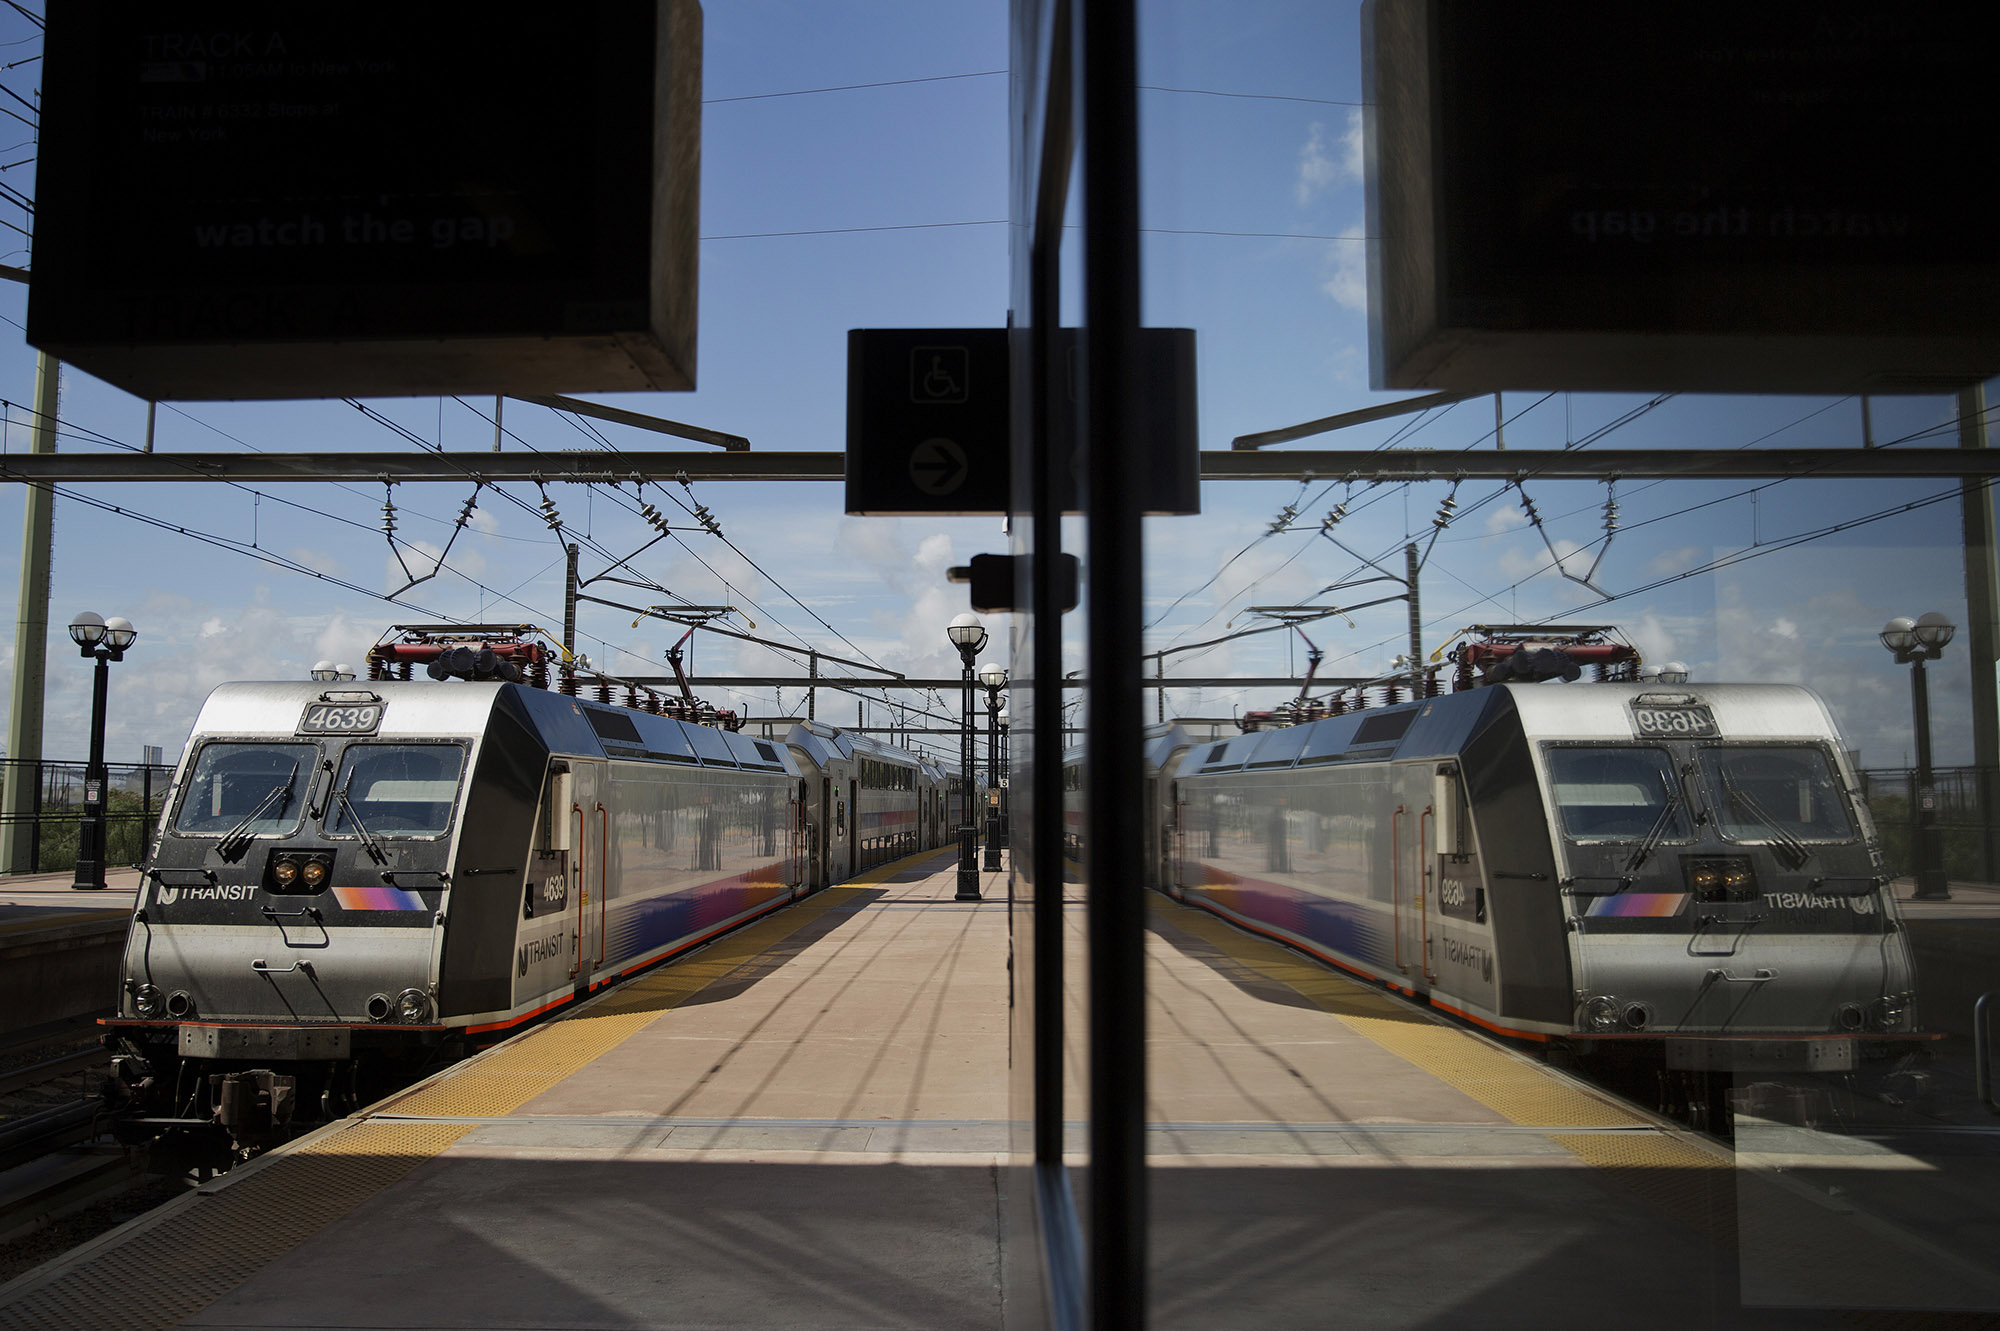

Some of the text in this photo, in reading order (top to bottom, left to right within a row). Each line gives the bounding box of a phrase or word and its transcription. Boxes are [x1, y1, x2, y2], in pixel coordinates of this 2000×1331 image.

[143, 31, 288, 57] TRACK A
[310, 60, 350, 78] New
[354, 57, 395, 76] York
[140, 105, 197, 121] TRAIN
[265, 102, 317, 120] Stops
[320, 102, 341, 116] at
[143, 127, 226, 143] New York
[194, 213, 516, 248] watch the gap
[118, 289, 365, 338] TRACK A
[309, 707, 375, 729] 4639
[181, 885, 259, 900] TRANSIT
[543, 874, 565, 902] 4639
[529, 933, 563, 965] TRANSIT
